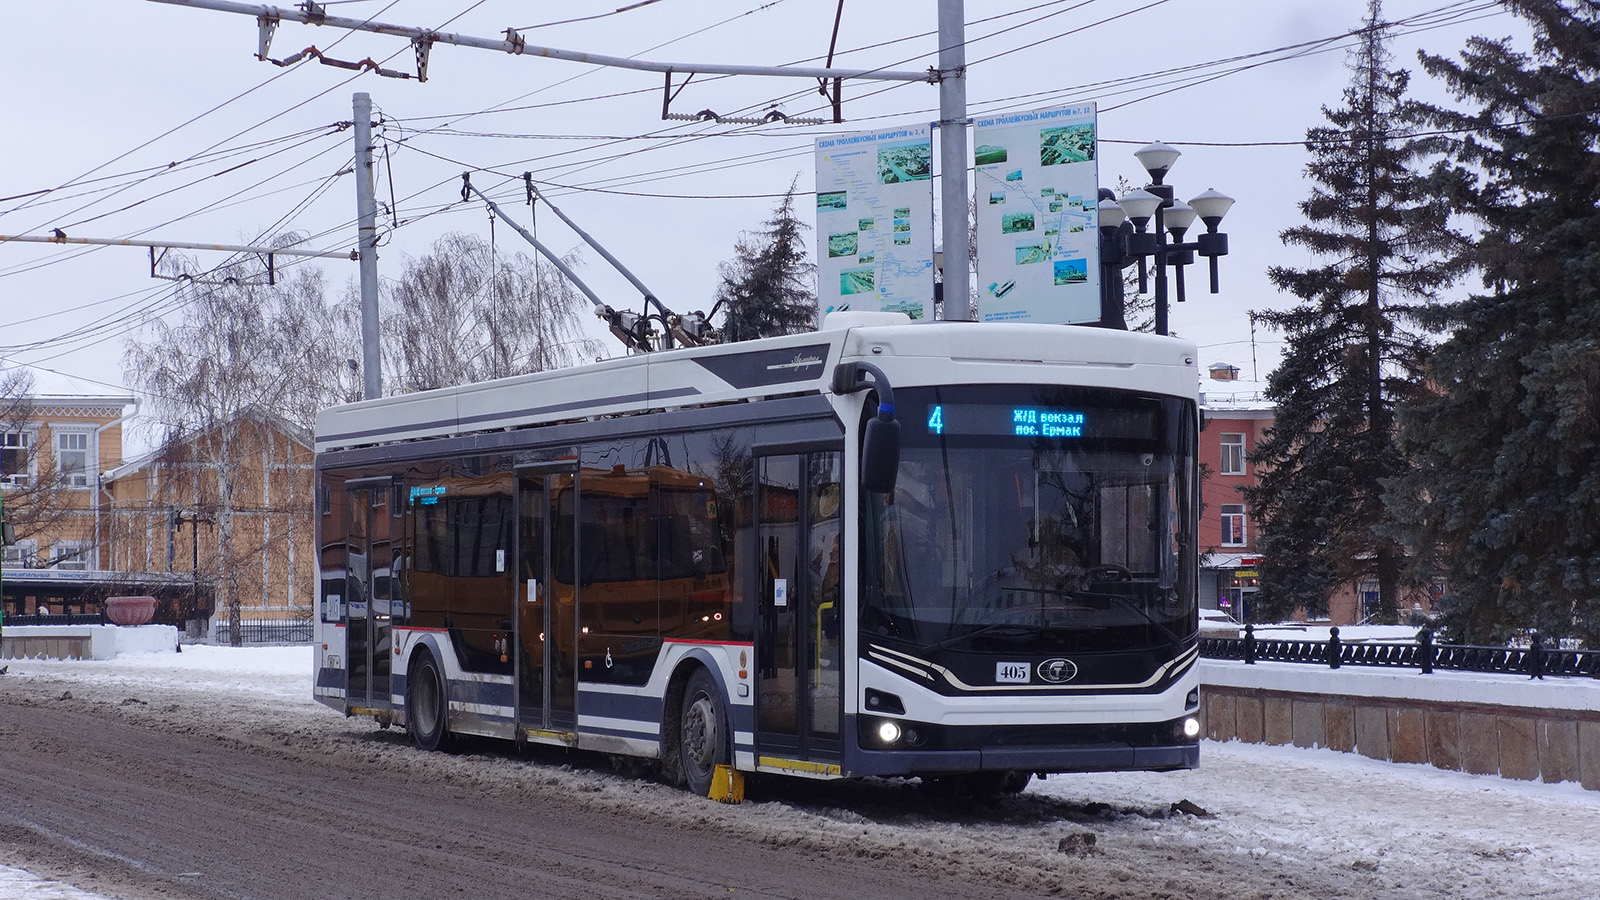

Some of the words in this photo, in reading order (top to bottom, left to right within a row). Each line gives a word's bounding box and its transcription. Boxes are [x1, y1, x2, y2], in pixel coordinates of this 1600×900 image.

[977, 118, 995, 128] СХЕМА
[995, 113, 1039, 125] ТРОЛЛЕЙБУСНЫХ
[1040, 108, 1071, 119] МАРШРУТОВ
[818, 140, 835, 149] СХЕМА
[836, 135, 877, 145] ТРОЛЛЕЙБУСНЫХ
[877, 129, 908, 140] МАРШРУТОВ
[928, 405, 943, 434] 4
[1013, 409, 1037, 424] Ж/Д
[1040, 412, 1084, 424] вокзал
[1015, 425, 1039, 435] пос.
[1042, 423, 1081, 437] Ермак
[1000, 666, 1027, 679] 405
